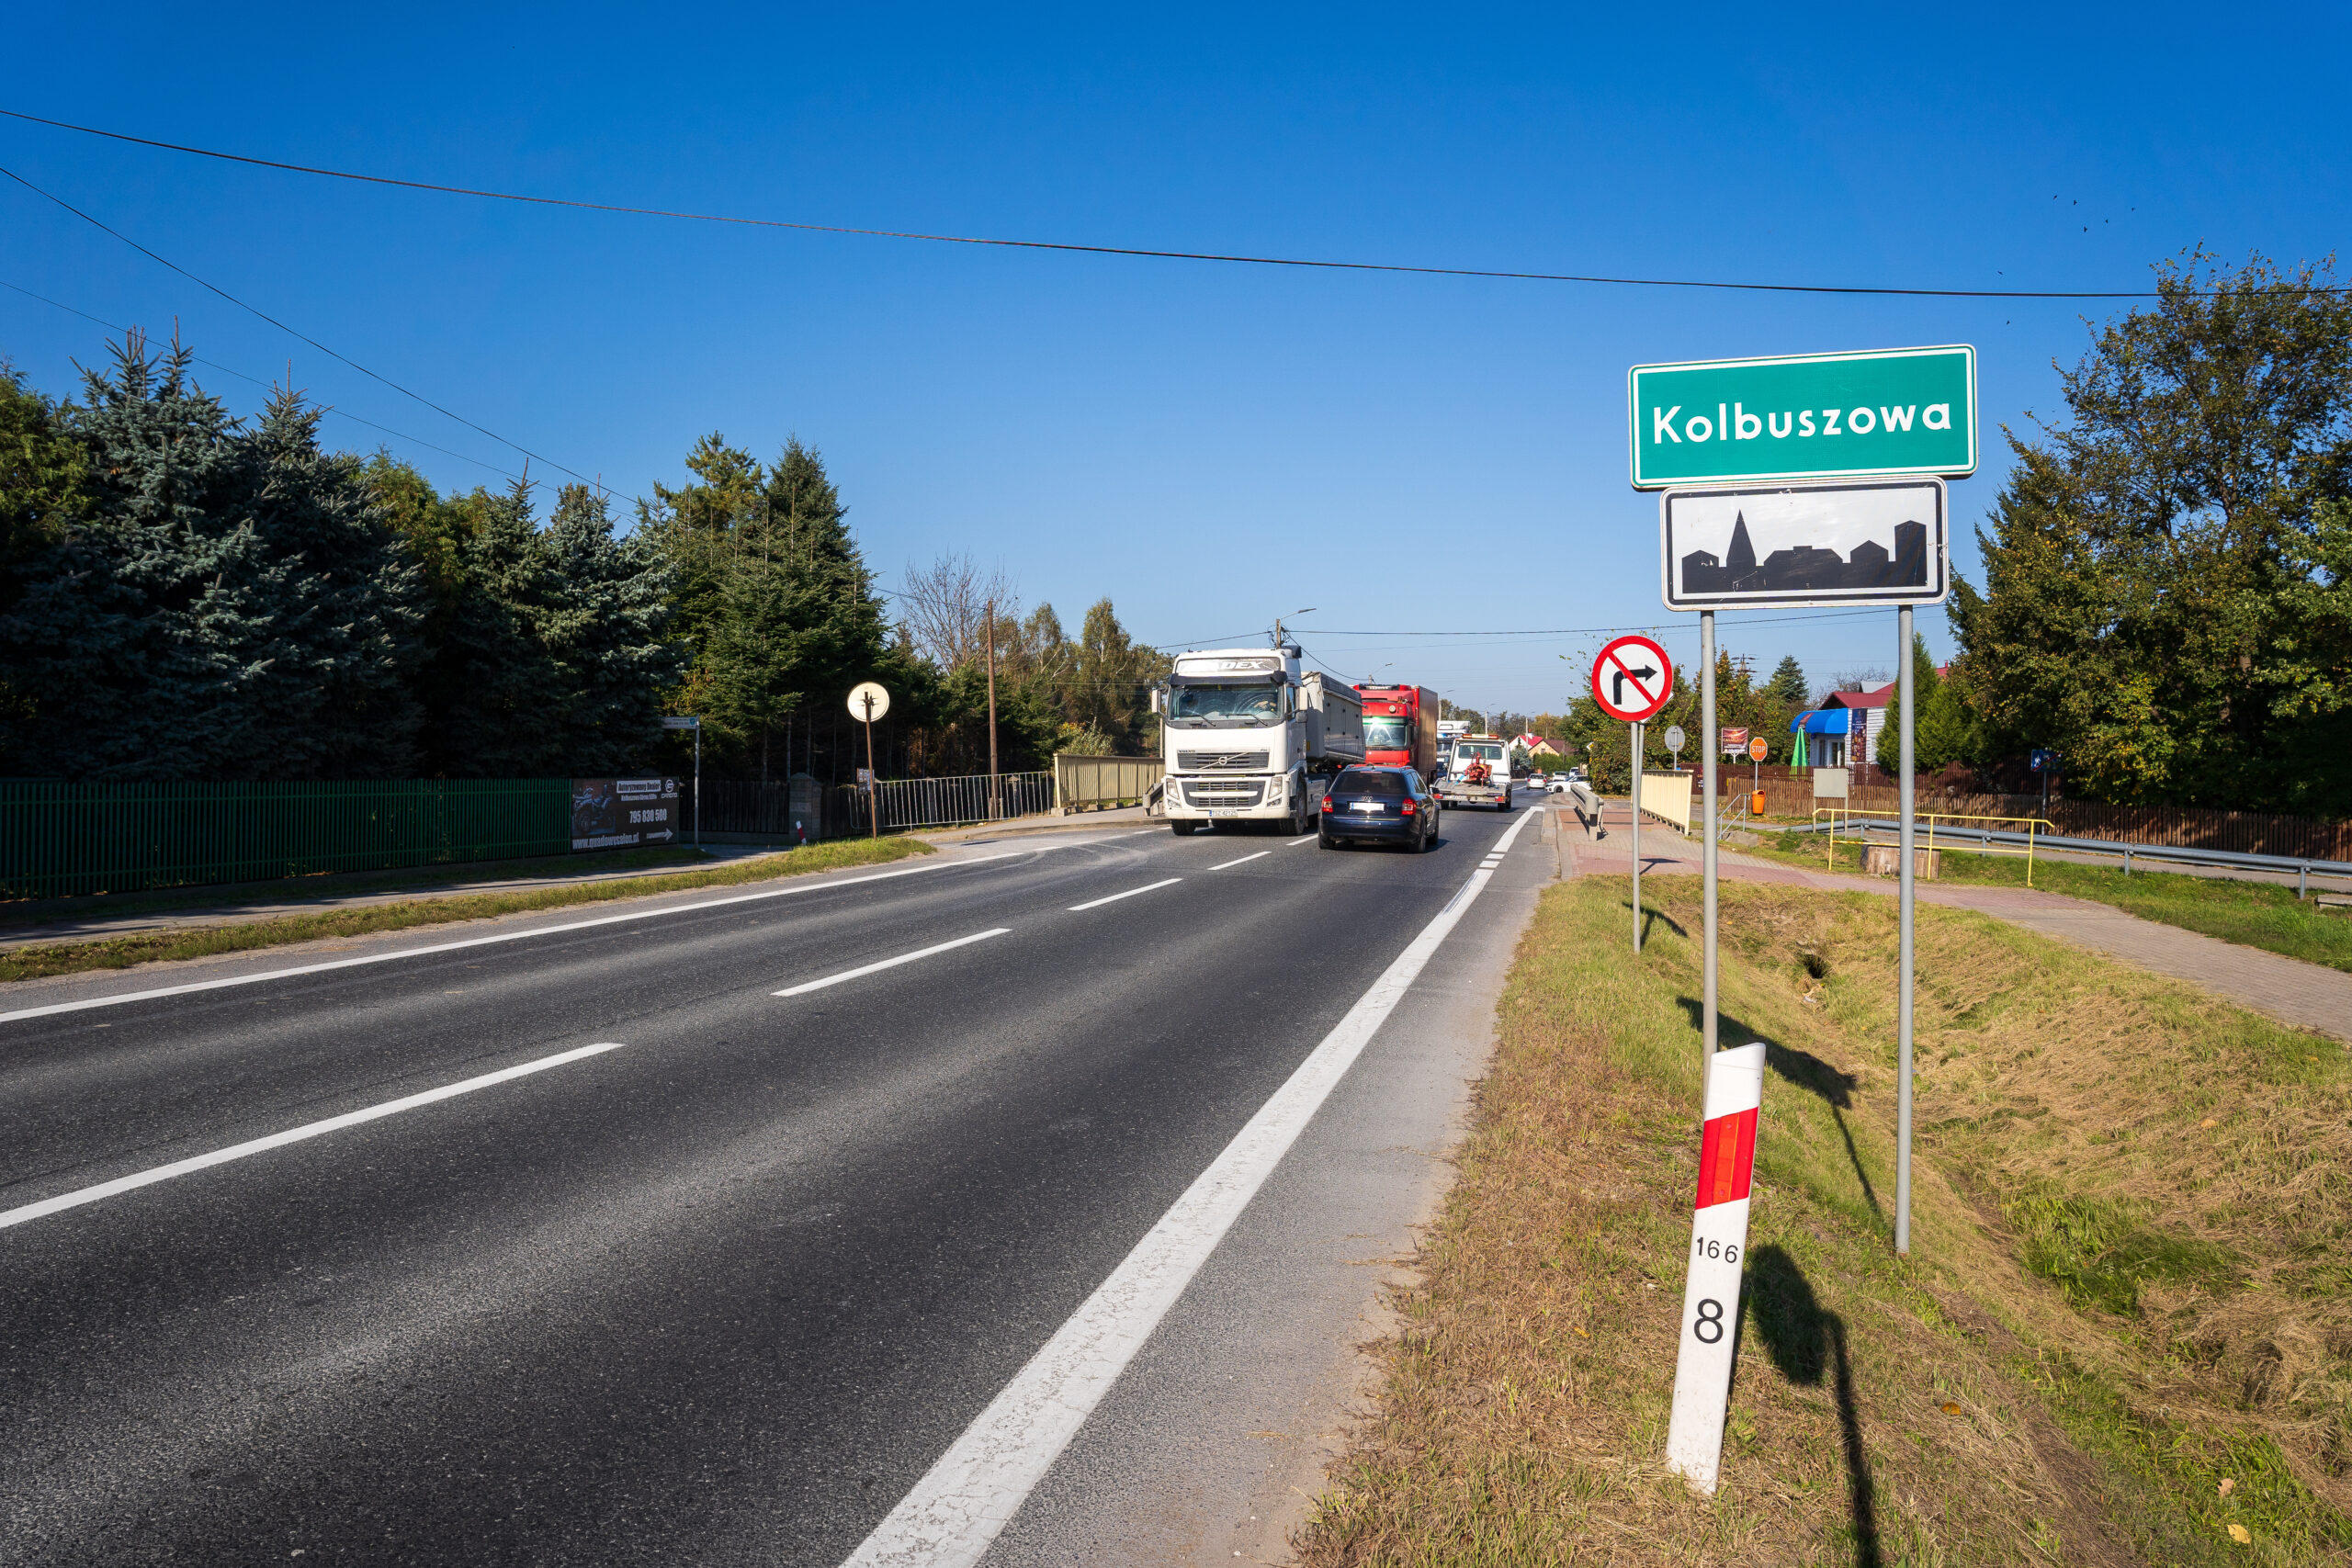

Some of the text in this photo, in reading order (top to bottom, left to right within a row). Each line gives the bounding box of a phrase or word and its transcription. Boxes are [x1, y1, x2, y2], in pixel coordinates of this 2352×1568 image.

[1654, 401, 1951, 445] Kolbuszowa
[1751, 745, 1766, 753] STOP
[629, 808, 667, 823] 795 830 500
[1697, 1236, 1738, 1263] 166
[1693, 1298, 1724, 1344] 8
